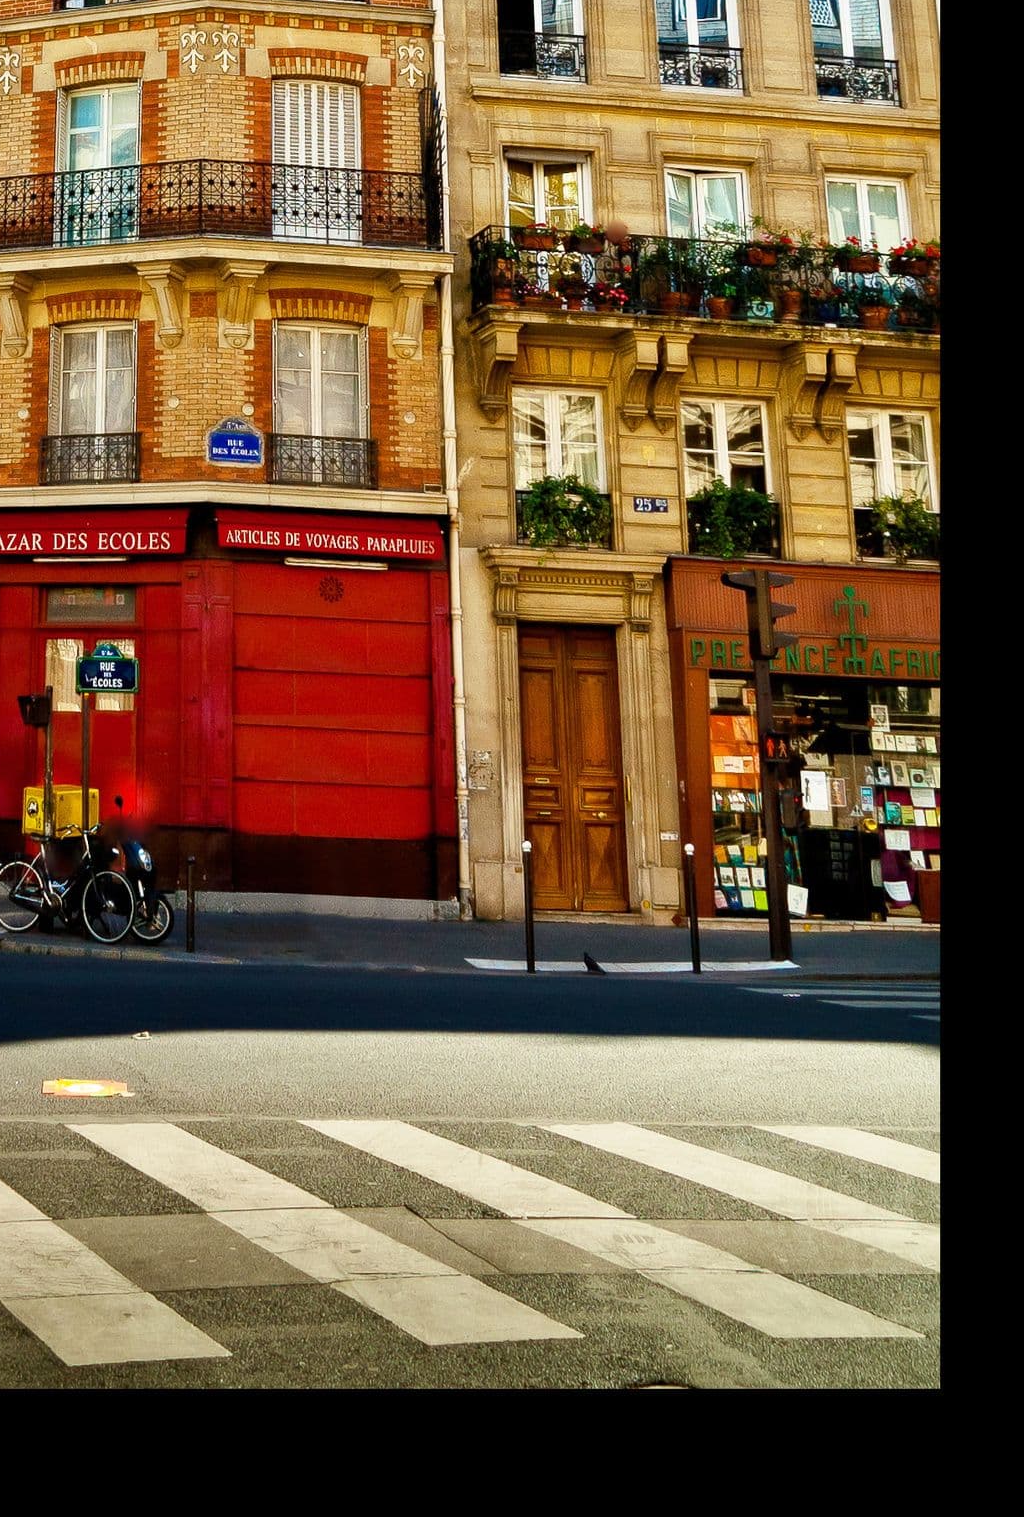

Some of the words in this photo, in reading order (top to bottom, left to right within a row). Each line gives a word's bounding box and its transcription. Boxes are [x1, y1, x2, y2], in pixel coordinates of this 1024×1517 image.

[227, 439, 244, 447] RUE
[231, 446, 259, 456] ÉCOLES
[636, 497, 652, 512] 25
[53, 532, 88, 550] DES
[98, 532, 171, 550] ECOLES
[226, 529, 280, 545] ARTICLES
[285, 532, 300, 547] DE
[306, 533, 359, 550] VOYAGES
[367, 537, 435, 554] PARAPLUIES
[690, 638, 838, 674] PREENCE
[100, 662, 116, 671] RUE
